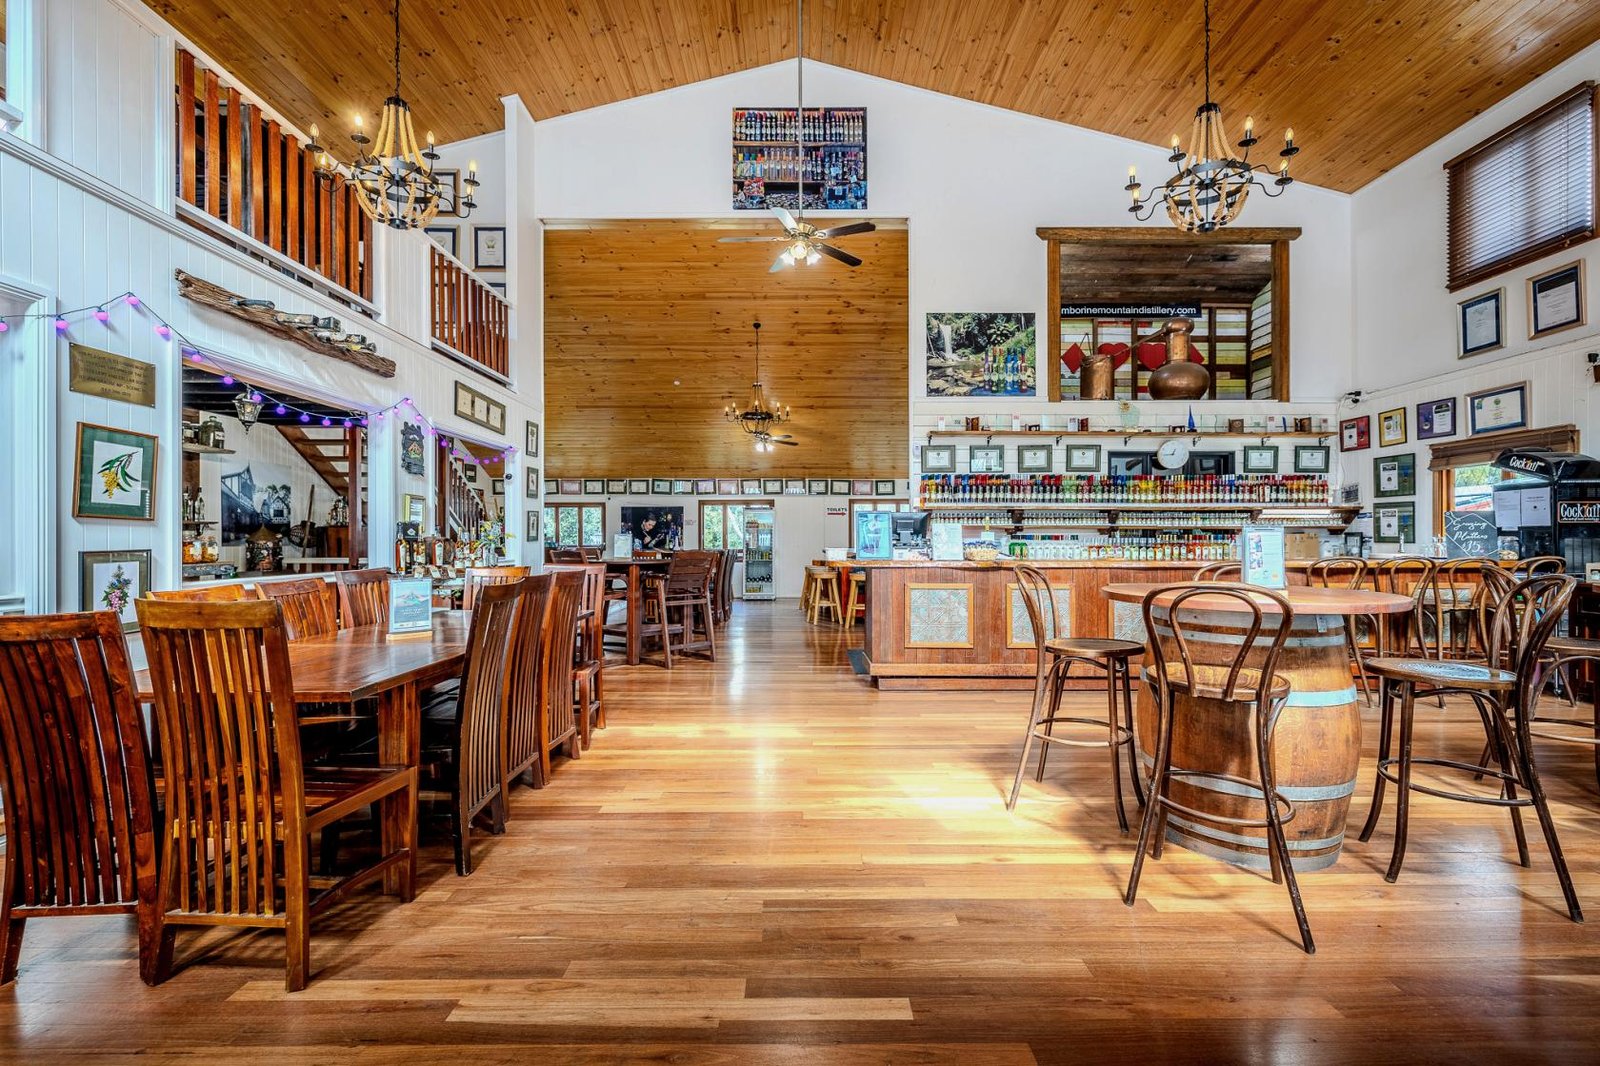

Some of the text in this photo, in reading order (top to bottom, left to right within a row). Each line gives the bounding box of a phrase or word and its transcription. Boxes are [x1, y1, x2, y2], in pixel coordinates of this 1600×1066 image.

[1061, 306, 1197, 316] mborinemountaindistillery.com
[1453, 519, 1488, 531] Grazing
[1453, 531, 1488, 541] Platters
